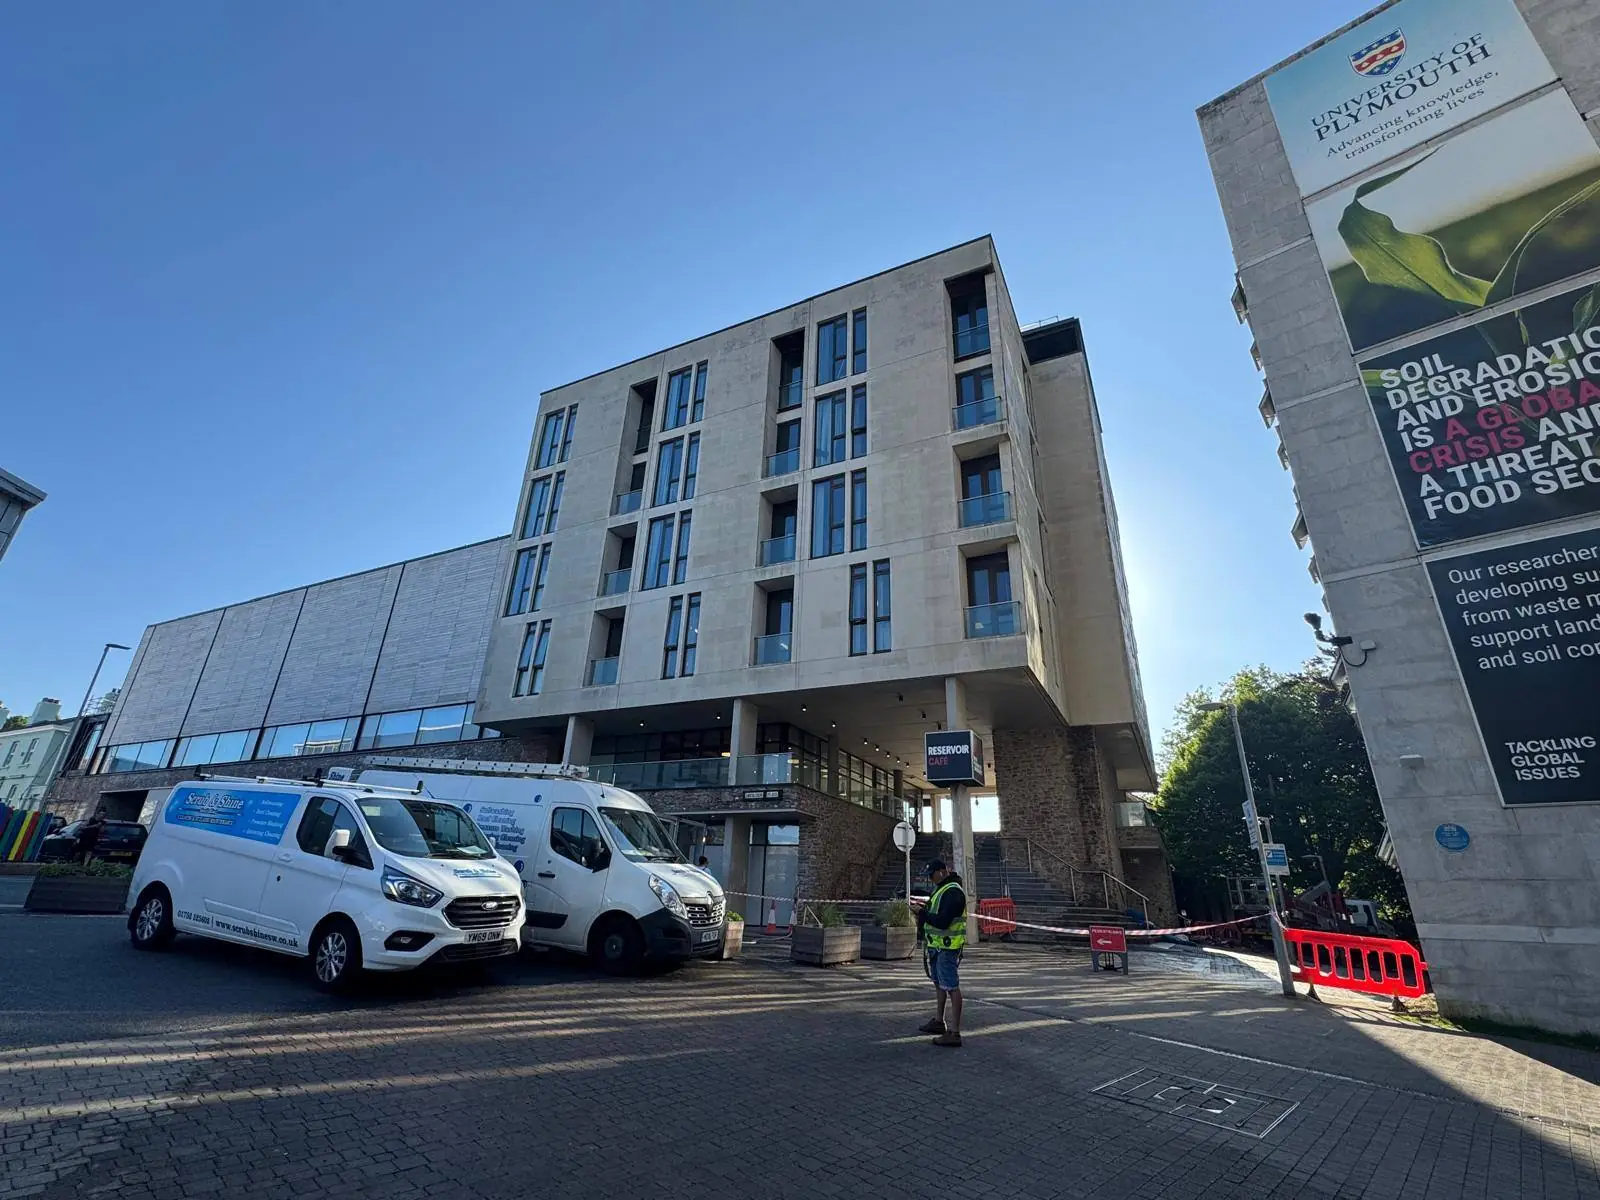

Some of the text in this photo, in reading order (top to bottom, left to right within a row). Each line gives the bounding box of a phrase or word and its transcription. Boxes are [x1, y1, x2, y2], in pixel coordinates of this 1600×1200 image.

[1310, 33, 1483, 127] UNIVERSITY OF
[1314, 43, 1492, 141] PLYMOUTH
[1327, 72, 1499, 157] Advancing knowledge,
[1344, 87, 1485, 160] transforming lives
[1380, 353, 1455, 389] SOIL
[1386, 326, 1600, 410] DEGRADATIO
[1397, 351, 1600, 431] AND EROSIO
[1400, 379, 1600, 453] IS A GLOBA
[1409, 426, 1526, 474] CRISIS
[1419, 432, 1595, 497] A THREAT
[1423, 458, 1600, 520] FOOD SEC
[1448, 546, 1600, 585] Our researcher
[1455, 568, 1600, 605] developing su
[1461, 607, 1511, 626] from
[1515, 594, 1581, 618] waste
[1470, 614, 1600, 648] support land
[1478, 650, 1517, 670] and
[1521, 643, 1561, 665] soil
[928, 745, 969, 755] RESERVOIR
[1504, 735, 1597, 754] TACKLING
[1510, 752, 1585, 768] GLOBAL
[1514, 766, 1580, 781] ISSUES
[185, 792, 208, 806] Scrub
[219, 794, 244, 809] Shine
[215, 920, 298, 947] www.scrubshinesw.co.uk
